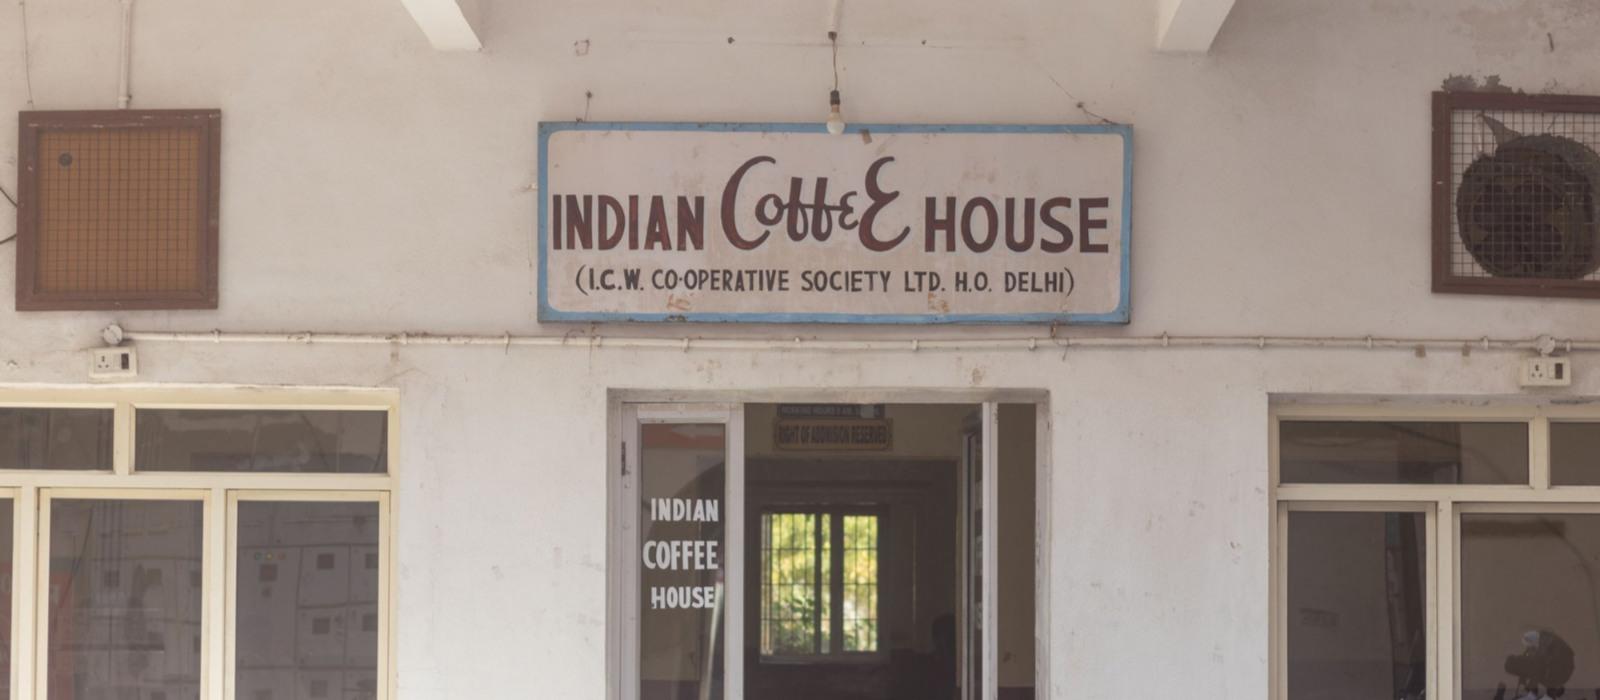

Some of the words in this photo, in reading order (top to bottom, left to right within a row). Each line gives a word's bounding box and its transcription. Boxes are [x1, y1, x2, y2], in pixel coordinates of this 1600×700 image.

[552, 194, 705, 251] INDIAN
[924, 196, 1109, 253] HOUSE
[575, 264, 644, 296] (I.C.W.
[800, 270, 891, 292] SOCIETY
[904, 271, 946, 293] LTD.
[954, 271, 993, 293] H.O.
[1004, 267, 1075, 297] DELHI)
[651, 498, 719, 522] INDIAN
[642, 540, 719, 570] COFFEE
[651, 586, 716, 609] HOUSE
